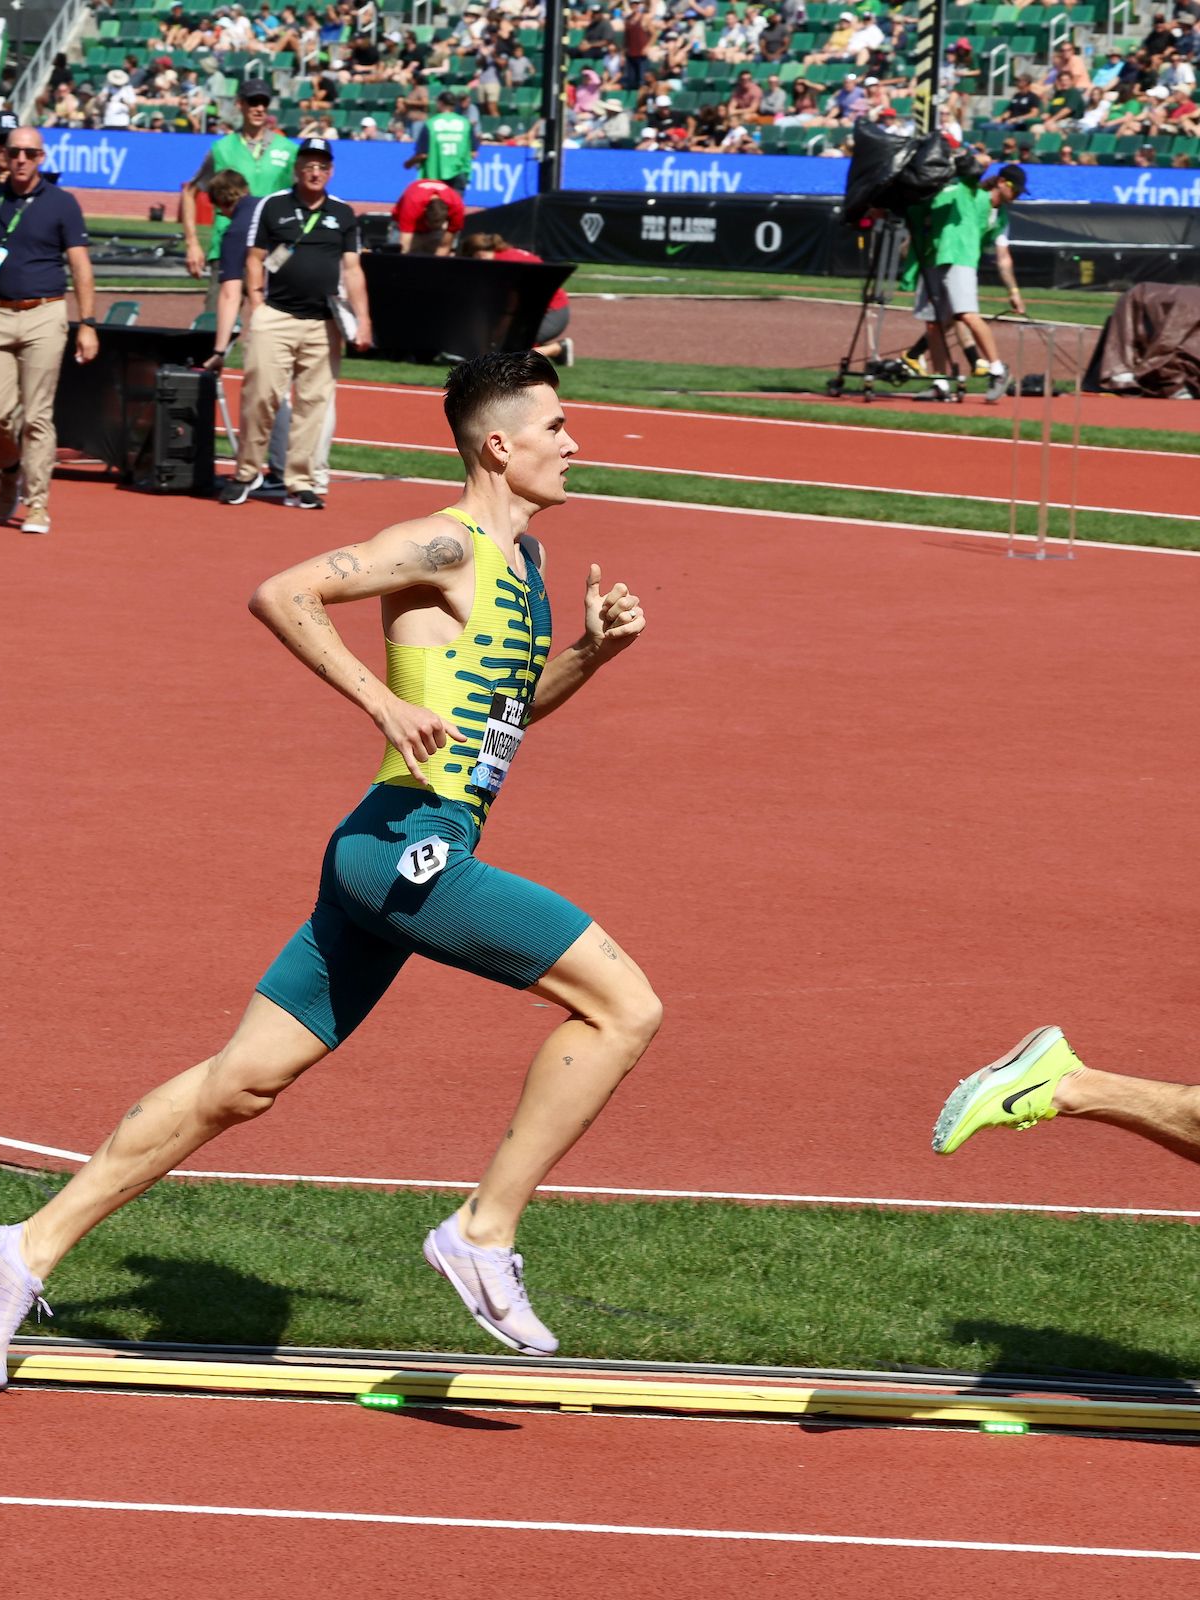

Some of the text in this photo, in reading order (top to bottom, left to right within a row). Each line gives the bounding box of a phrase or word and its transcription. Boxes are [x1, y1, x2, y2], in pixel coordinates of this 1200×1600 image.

[470, 153, 524, 205] nity
[1112, 172, 1200, 207] xfinit
[502, 697, 525, 726] PRE
[410, 843, 441, 877] 13
